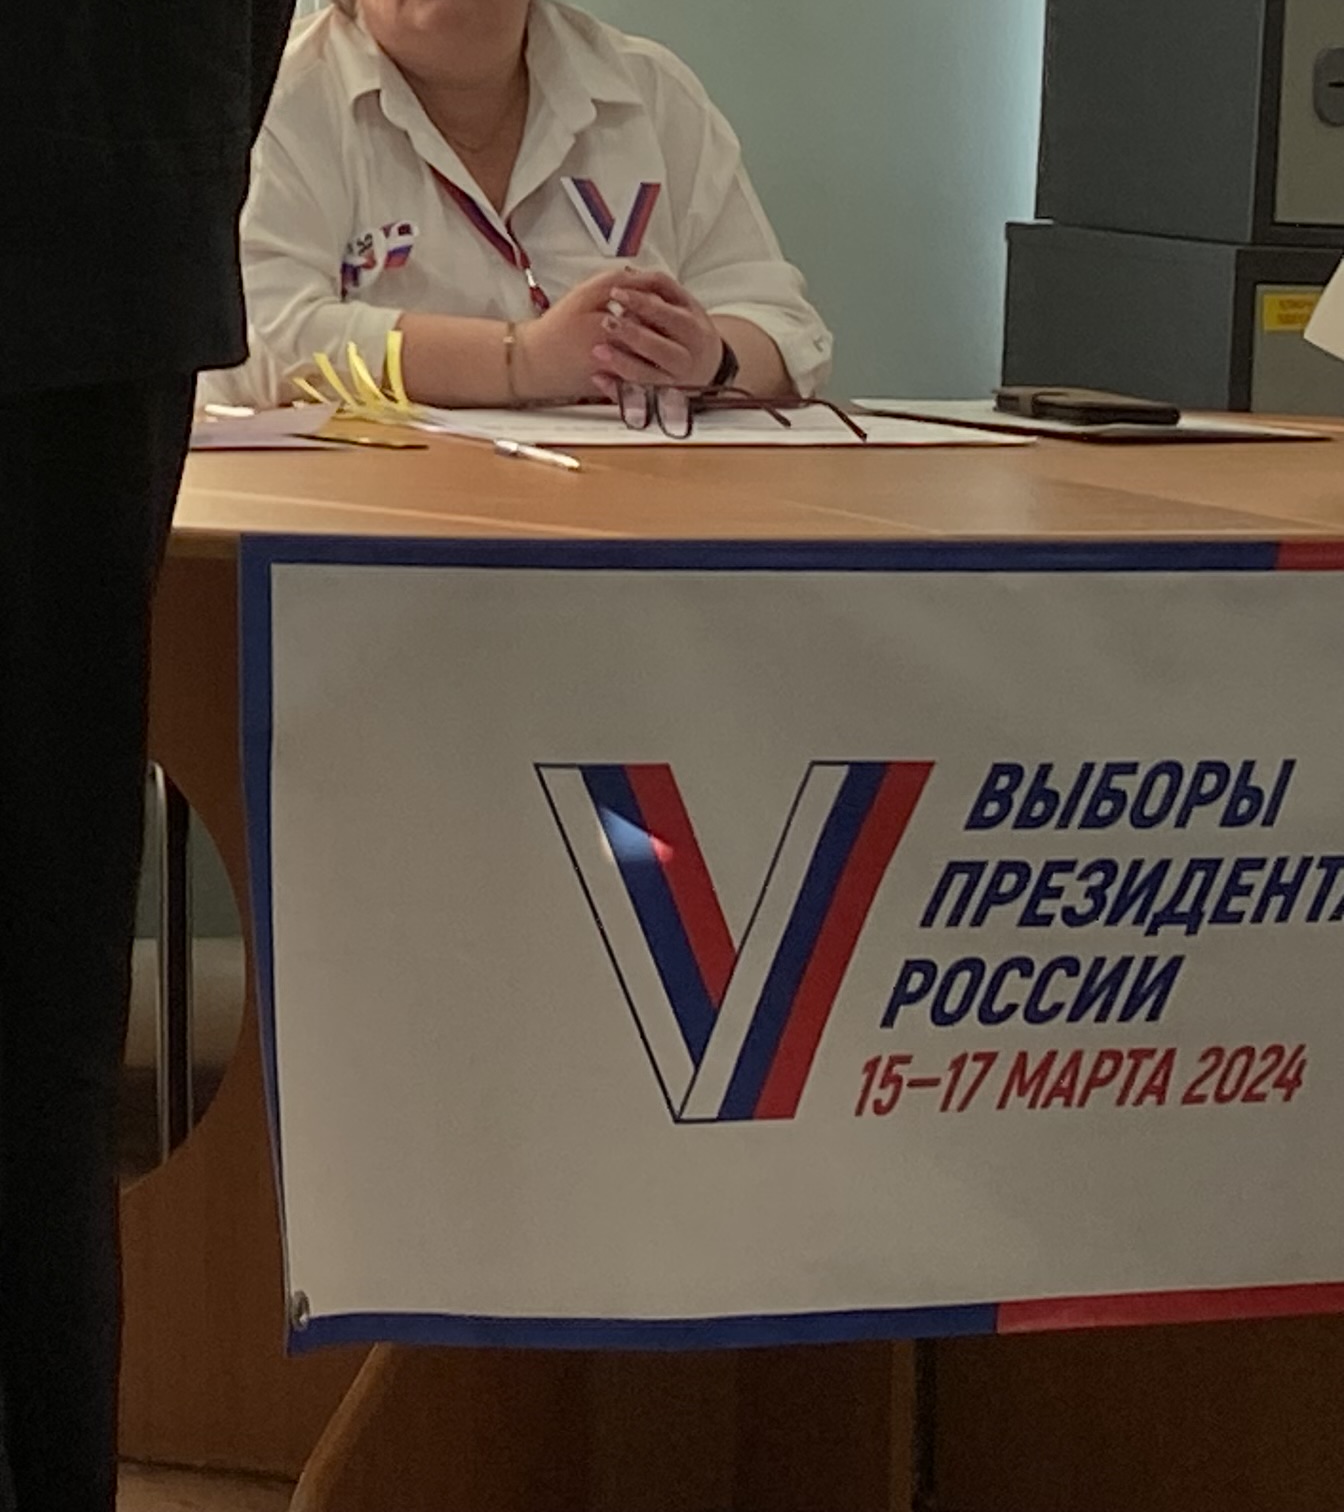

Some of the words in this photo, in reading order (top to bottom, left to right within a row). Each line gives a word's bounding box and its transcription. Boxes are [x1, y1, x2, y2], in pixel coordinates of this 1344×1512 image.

[963, 758, 1298, 831] ВЫБОРЫ
[918, 854, 1344, 937] ПРЕЗИДЕНТ
[878, 954, 1186, 1029] РОССИИ
[996, 1047, 1177, 1111] МАРТА
[1181, 1043, 1308, 1107] 2024
